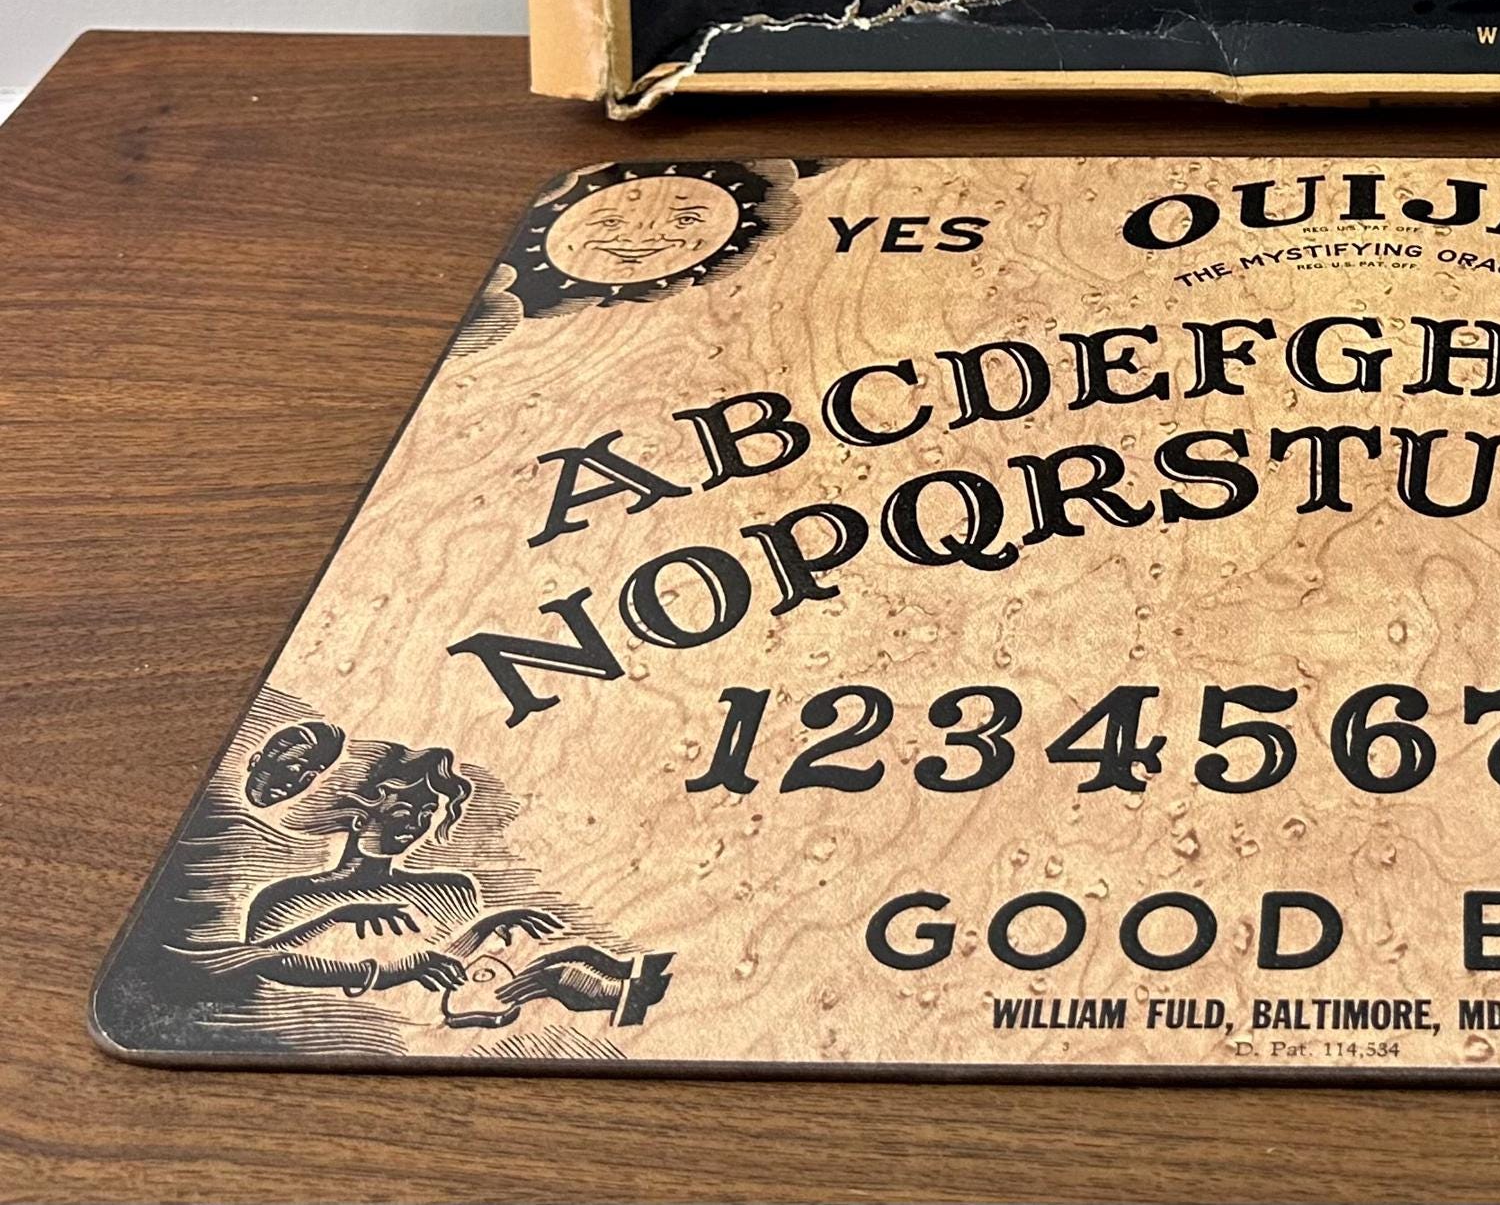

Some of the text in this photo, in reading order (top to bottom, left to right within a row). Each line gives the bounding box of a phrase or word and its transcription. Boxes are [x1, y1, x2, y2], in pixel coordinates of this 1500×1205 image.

[826, 215, 992, 254] YES
[1174, 261, 1233, 288] THE
[1239, 241, 1424, 270] MYSTIFYING
[864, 890, 1346, 974] GOOD
[992, 997, 1128, 1030] WILLIAM
[1146, 998, 1235, 1037] FULD,
[1251, 998, 1441, 1037] BALTIMORE,
[1235, 1041, 1400, 1059] D. Pat. 114,534
